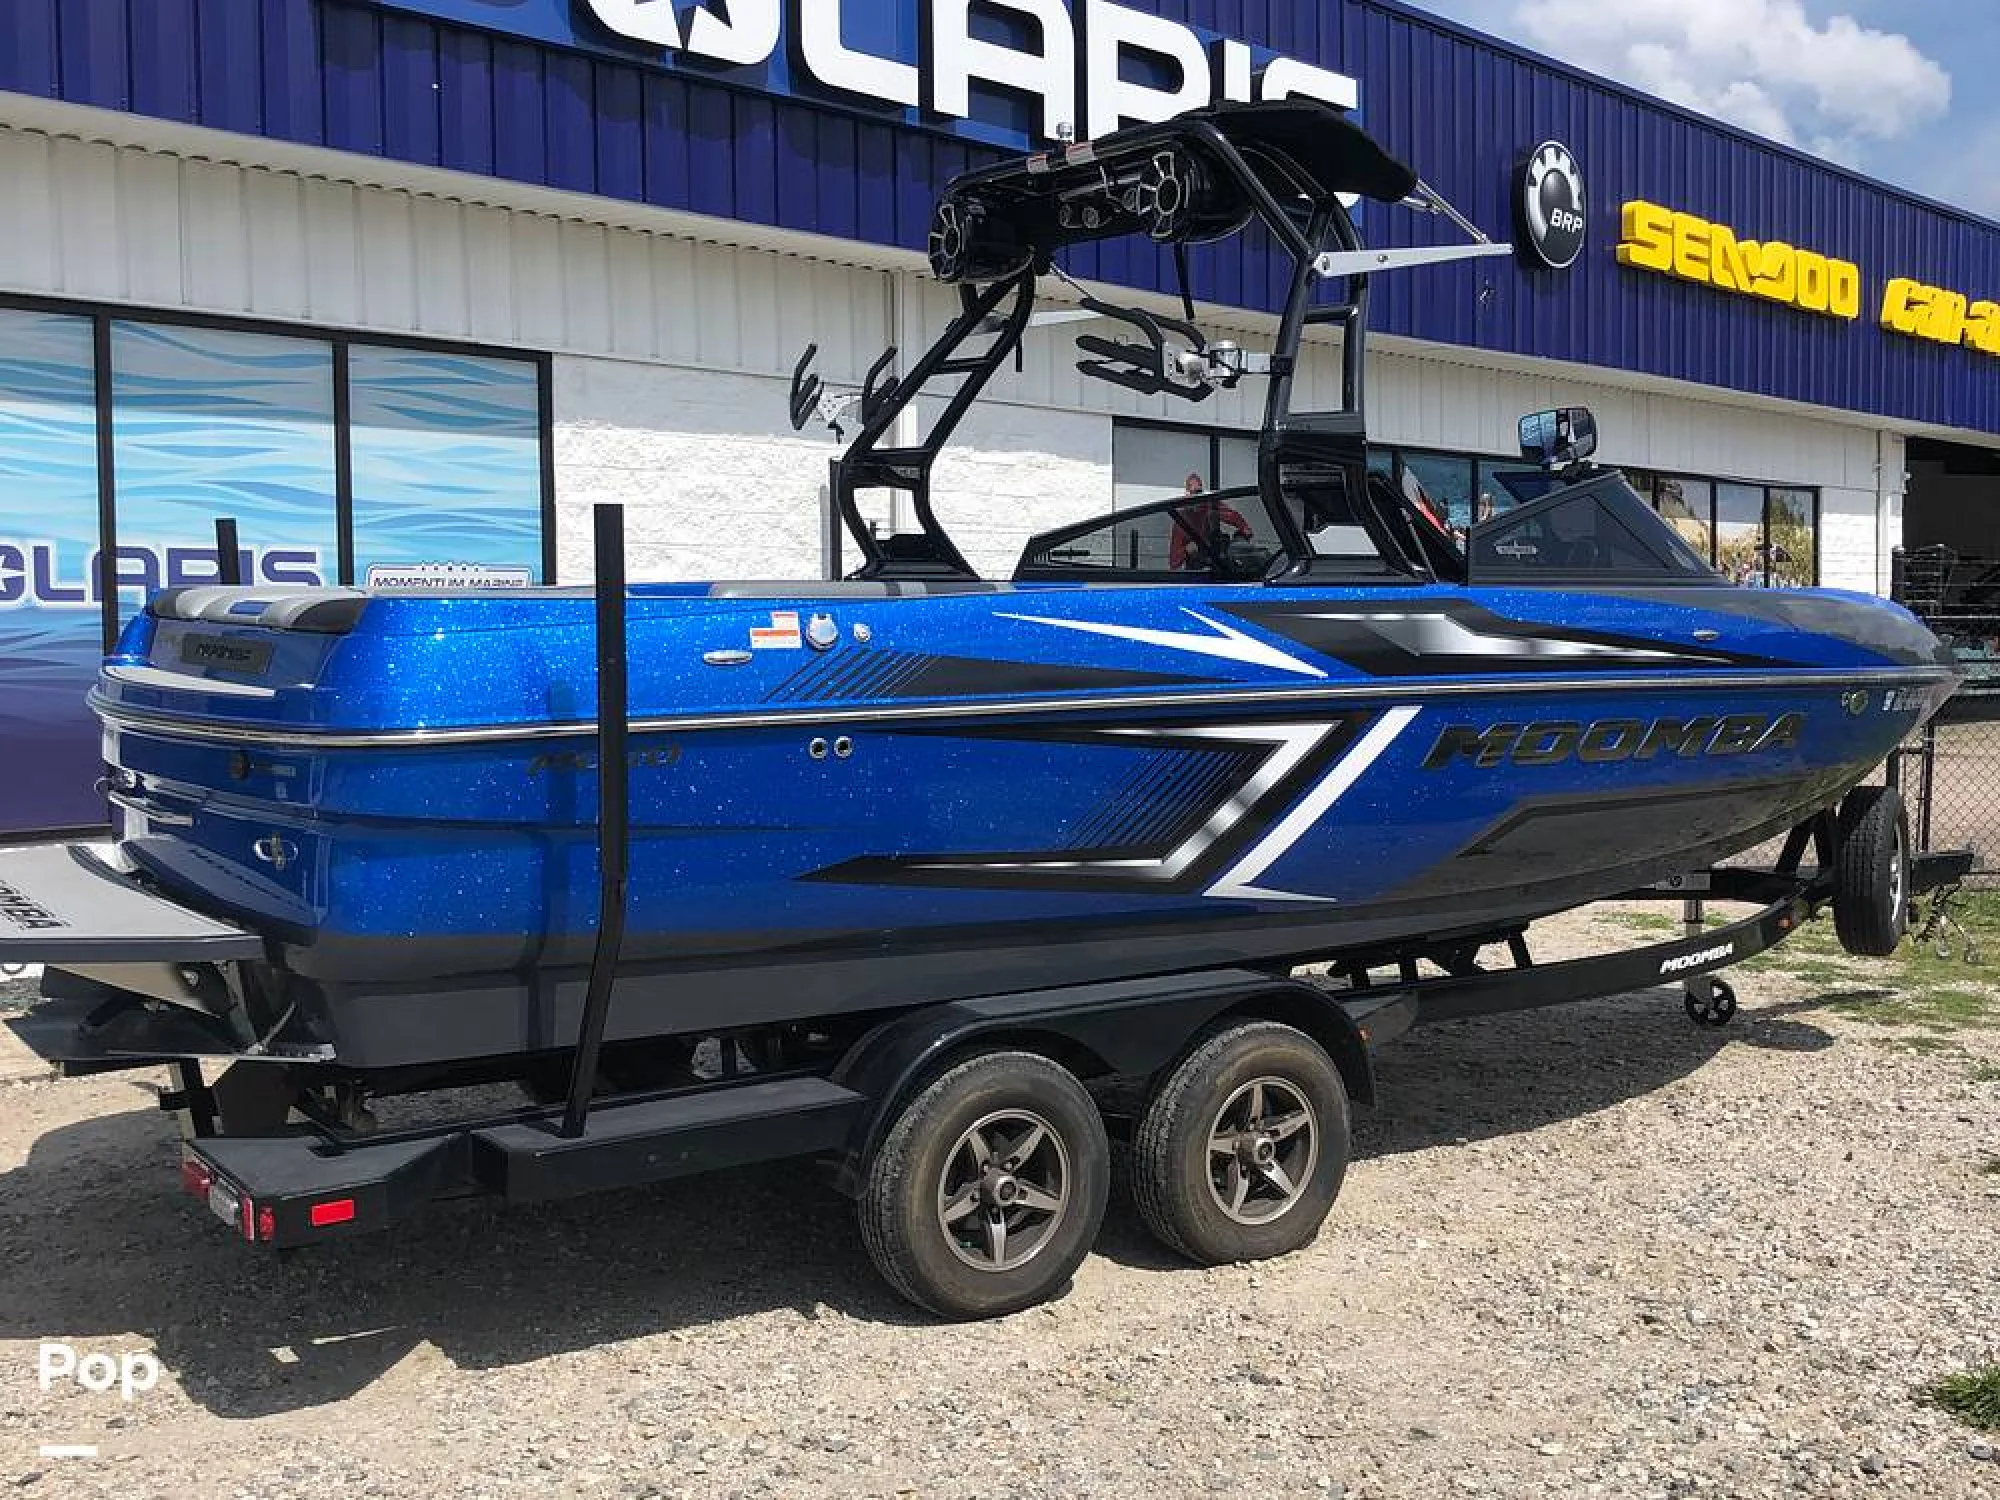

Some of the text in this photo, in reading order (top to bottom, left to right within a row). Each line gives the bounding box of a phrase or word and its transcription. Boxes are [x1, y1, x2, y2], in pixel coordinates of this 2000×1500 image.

[1551, 207, 1583, 233] BRP
[1420, 712, 1806, 770] MOOMBA
[1659, 942, 1734, 975] MOOMBA
